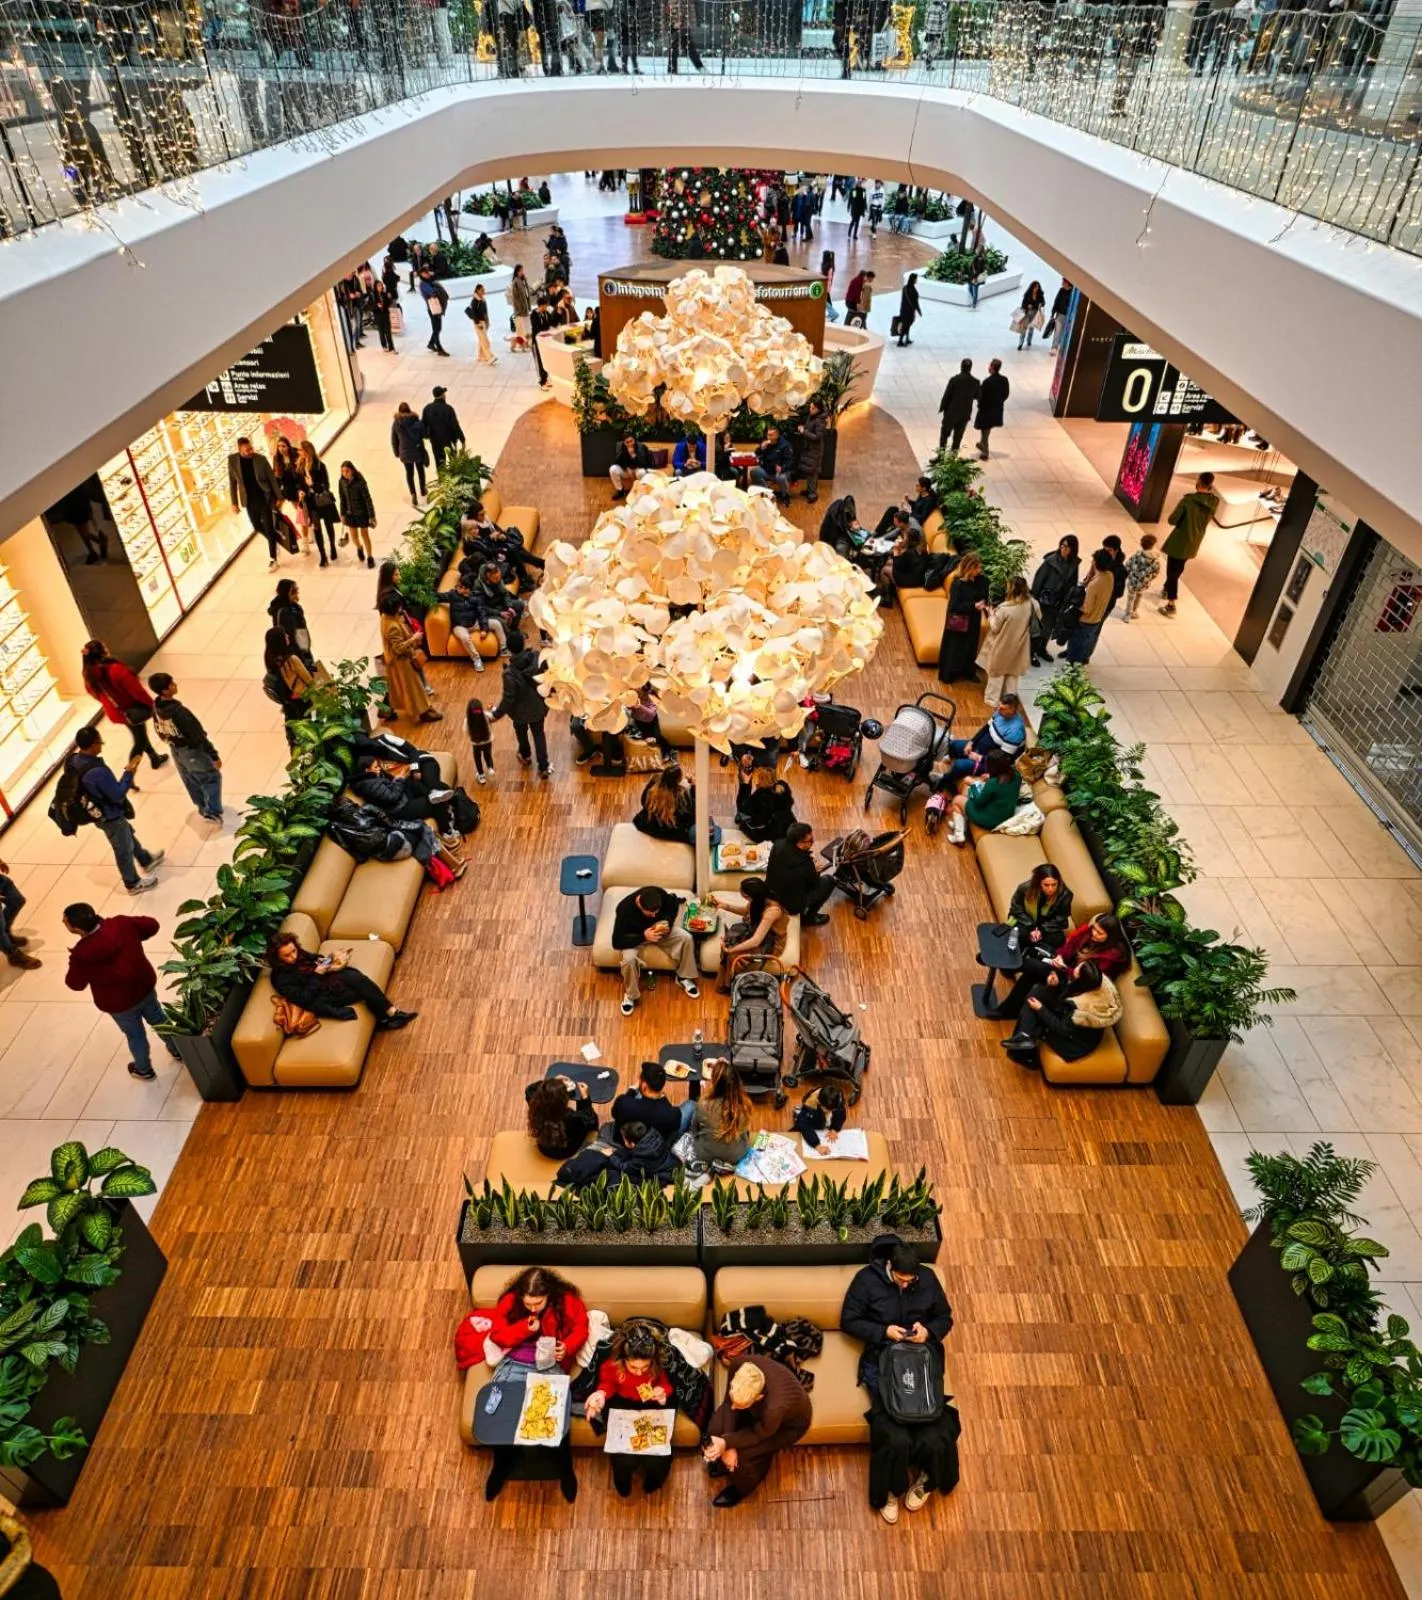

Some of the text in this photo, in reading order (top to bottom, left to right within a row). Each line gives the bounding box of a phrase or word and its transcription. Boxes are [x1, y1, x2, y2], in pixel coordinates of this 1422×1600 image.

[754, 285, 808, 299] fotourism
[250, 371, 290, 379] informazioni
[1122, 368, 1153, 413] 0
[1182, 403, 1205, 411] Servizi
